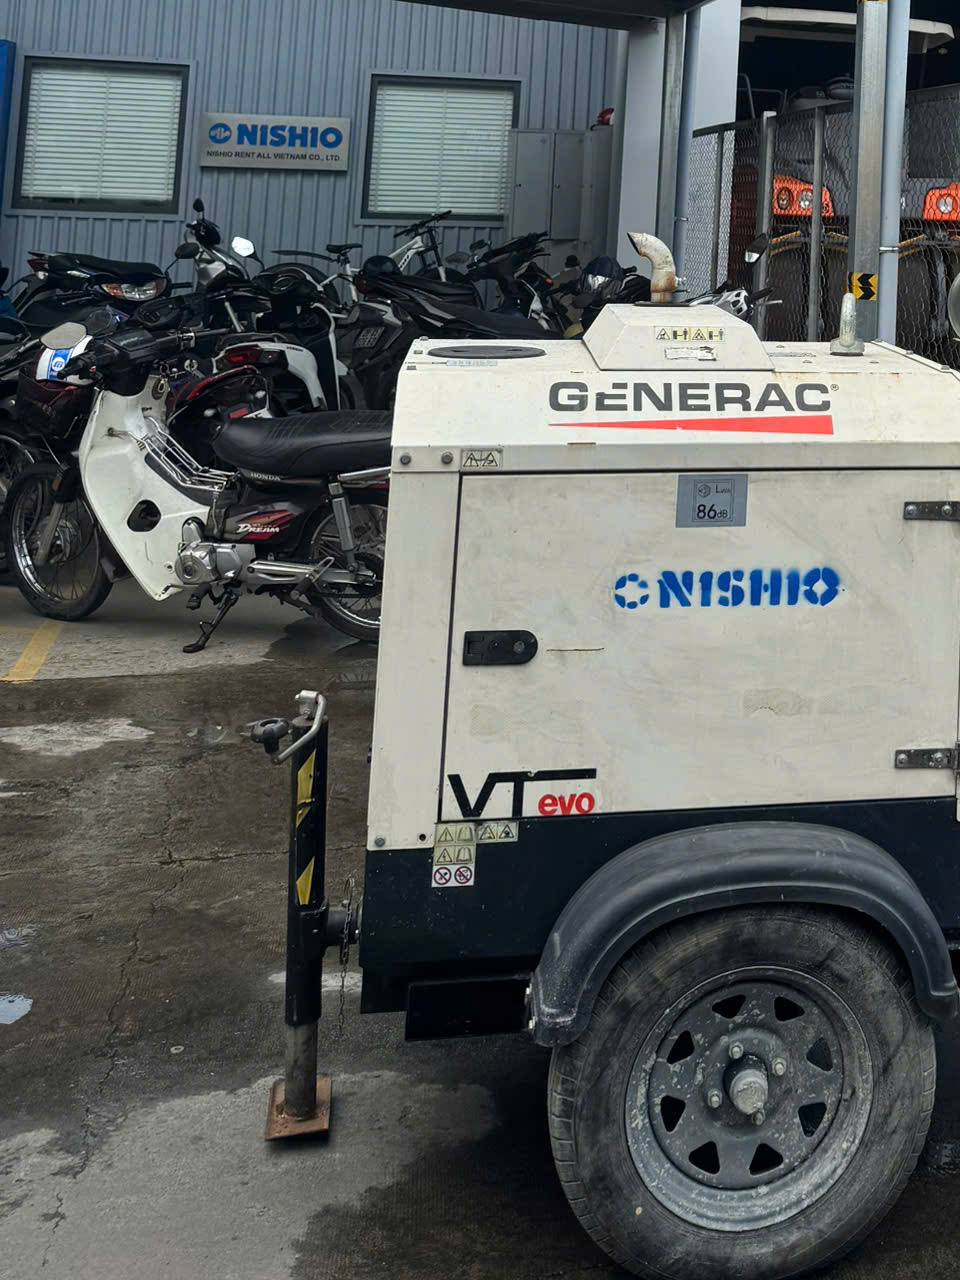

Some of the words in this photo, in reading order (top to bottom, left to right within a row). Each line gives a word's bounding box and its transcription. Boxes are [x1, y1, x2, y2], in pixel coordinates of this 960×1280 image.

[236, 123, 343, 149] NISHIO
[206, 150, 233, 158] NISHIO
[234, 151, 255, 159] RENT
[256, 151, 272, 160] ALL
[273, 153, 307, 161] VIETNAM
[250, 471, 281, 481] HONDA
[657, 567, 840, 608] NISHIO
[447, 767, 597, 819] VT
[537, 792, 595, 817] evo
